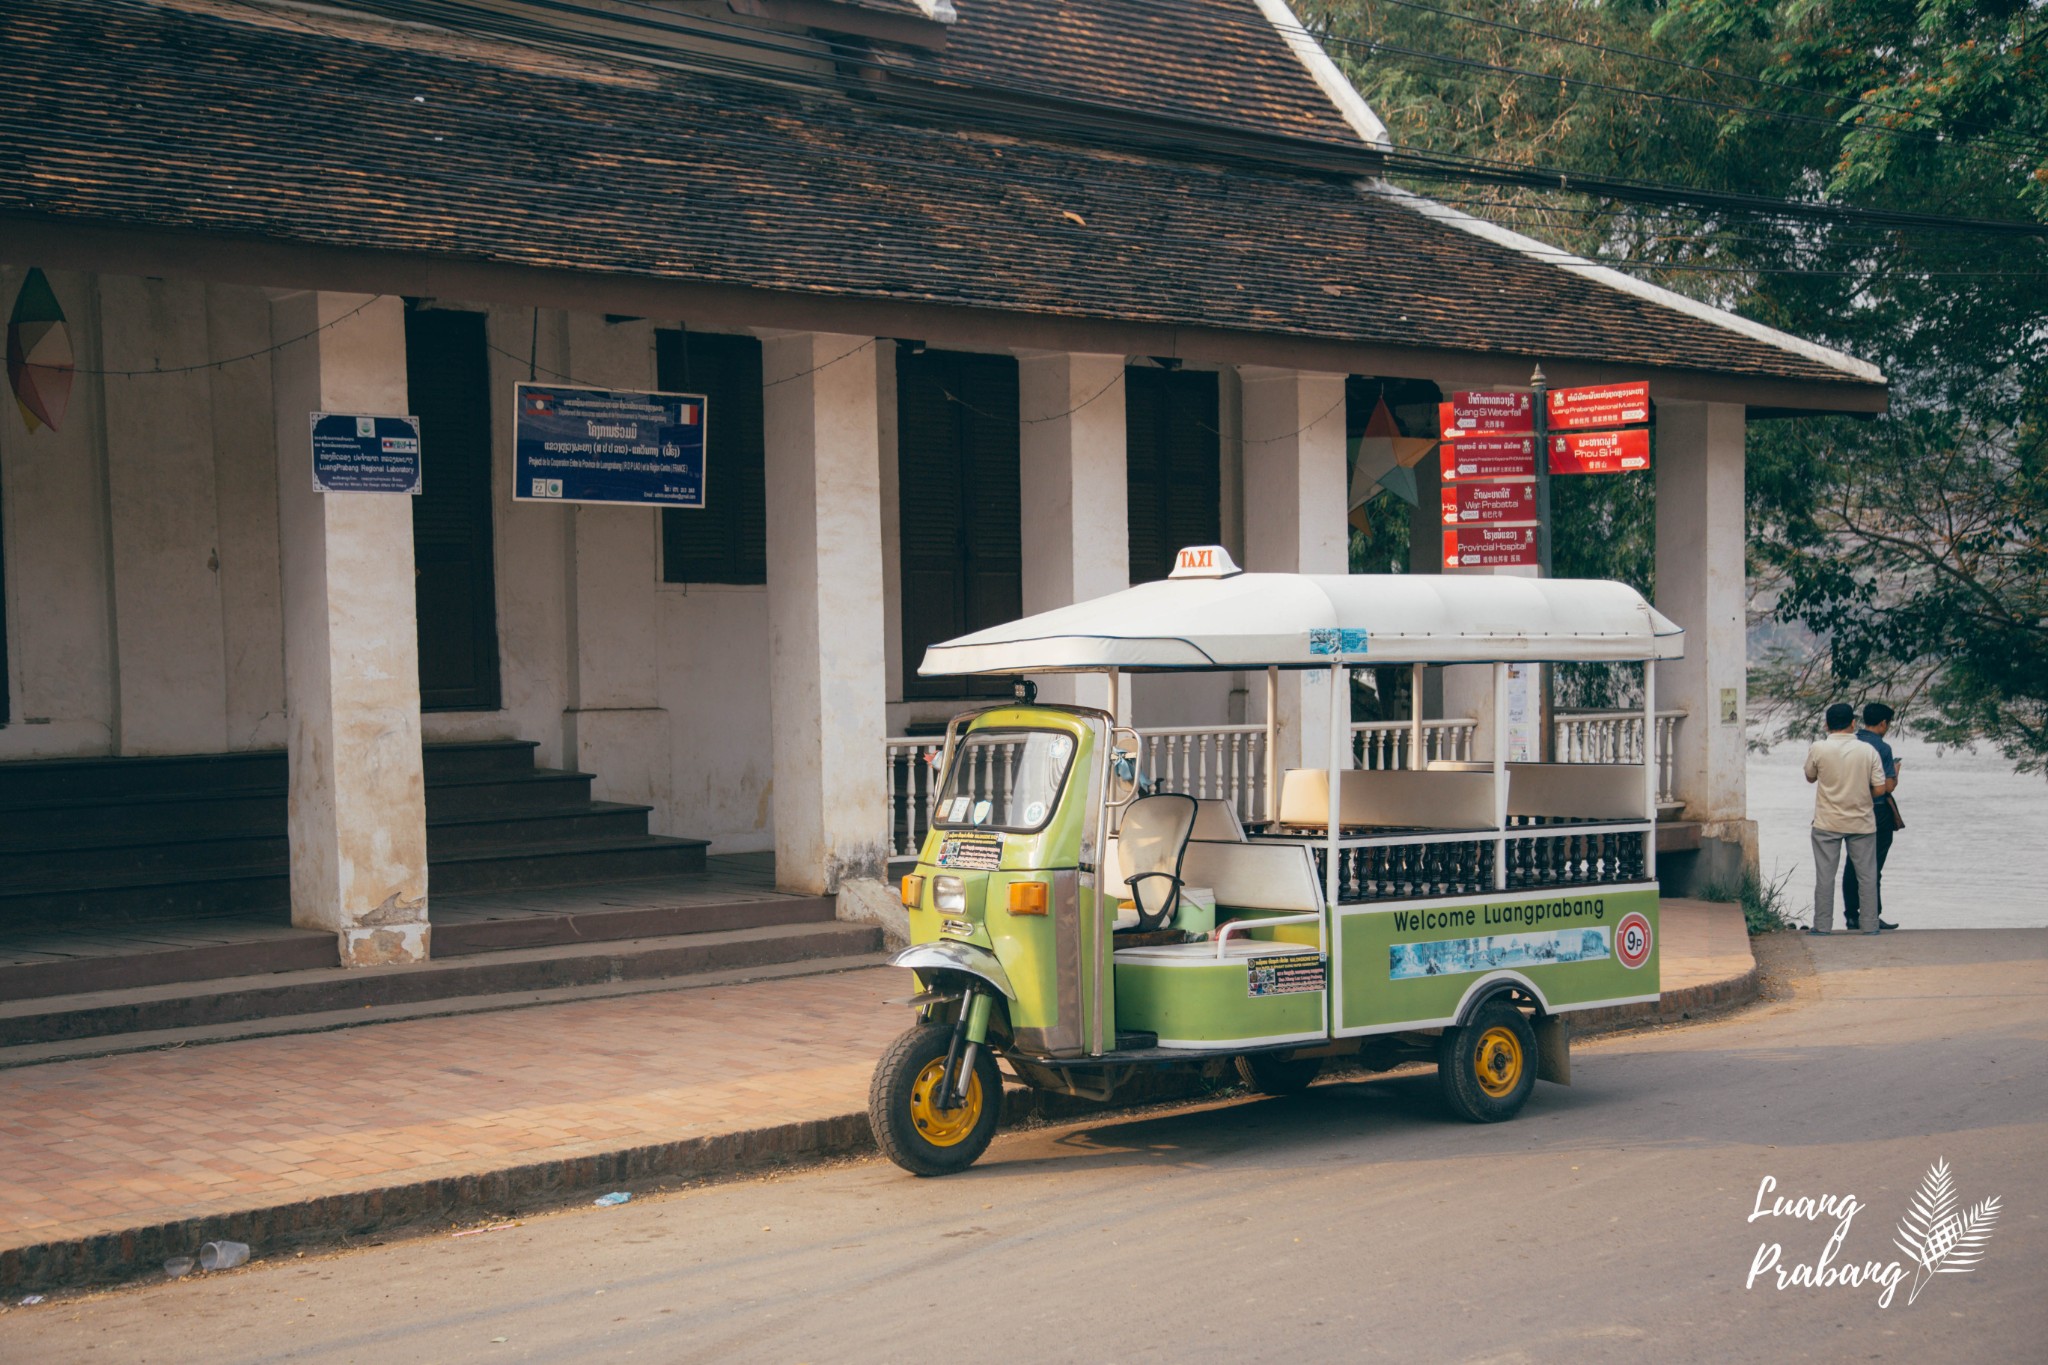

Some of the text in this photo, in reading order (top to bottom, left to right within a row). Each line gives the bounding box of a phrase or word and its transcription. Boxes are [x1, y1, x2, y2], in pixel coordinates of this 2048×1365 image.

[1595, 403, 1619, 411] National
[1454, 408, 1521, 418] Kuang Si Waterfall
[1574, 448, 1622, 458] Phou Si Hill
[361, 464, 384, 473] Regional
[386, 466, 414, 474] Laboratory
[1482, 500, 1519, 509] Prabattai
[1458, 543, 1526, 552] Provincial Hospital
[1180, 550, 1213, 568] TAXI
[1394, 898, 1604, 932] Welcome Luangprabang
